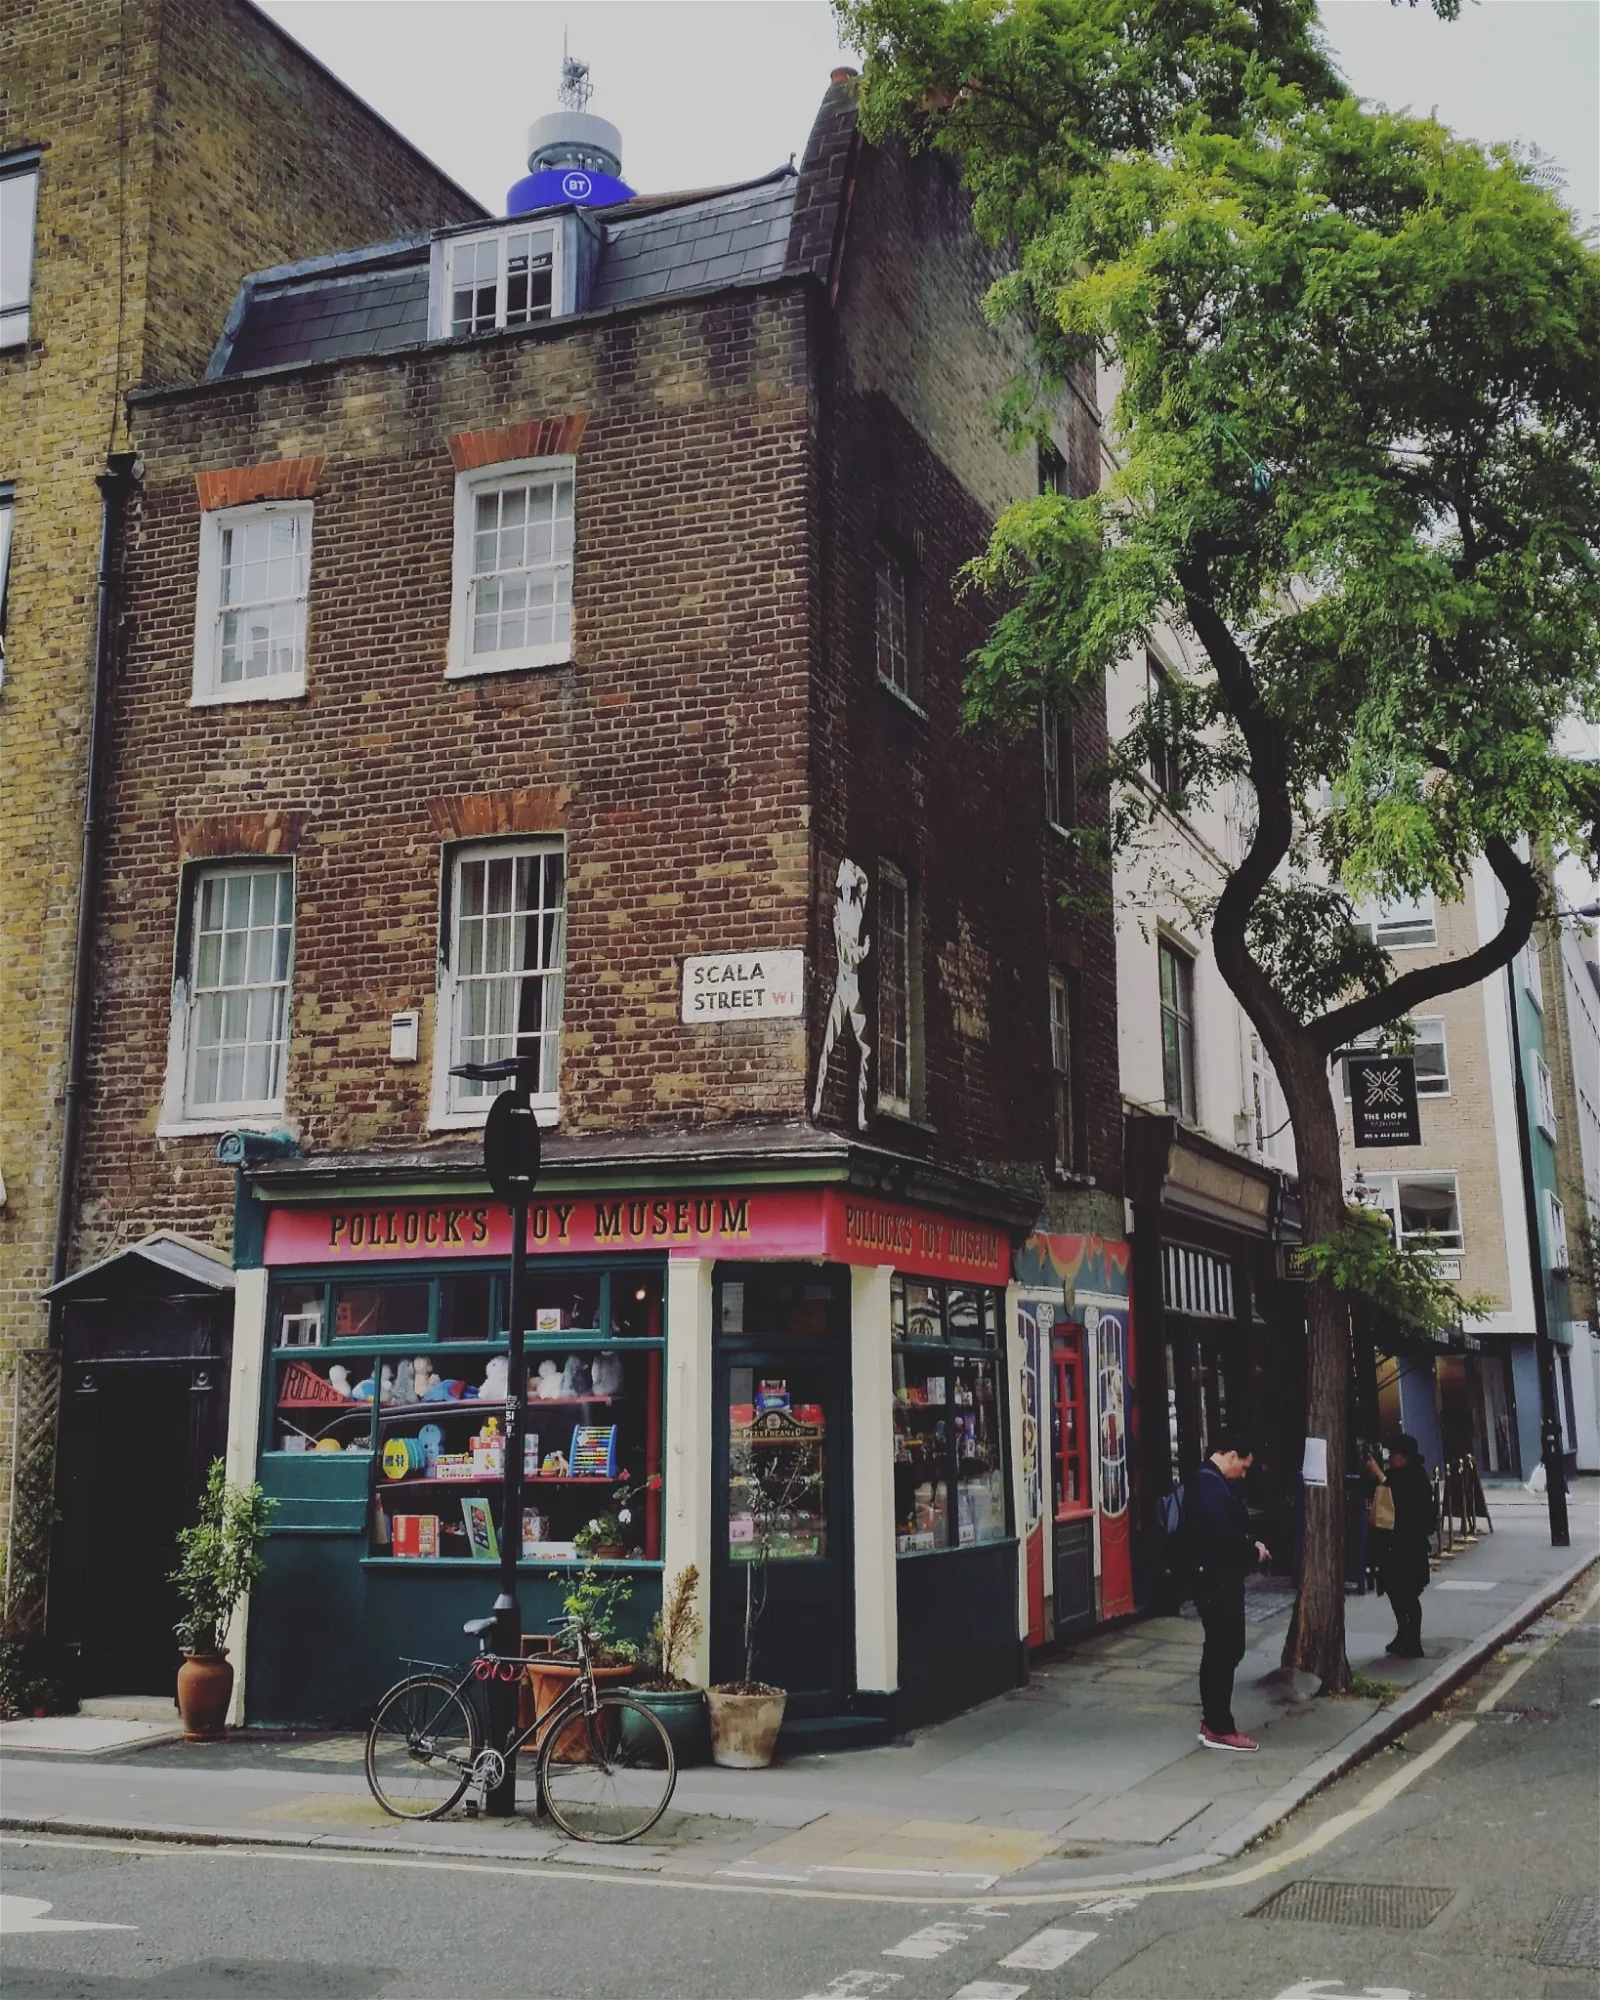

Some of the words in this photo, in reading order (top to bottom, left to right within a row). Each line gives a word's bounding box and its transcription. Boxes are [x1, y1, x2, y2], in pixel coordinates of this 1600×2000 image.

[569, 180, 585, 191] BT
[694, 963, 766, 985] SCALA
[694, 988, 766, 1011] STREET
[1364, 1113, 1380, 1121] THE
[1383, 1112, 1408, 1120] HOPE
[328, 1206, 490, 1254] POLLOCK'S
[508, 1204, 577, 1246] OY
[594, 1197, 752, 1245] MUSEUM
[845, 1204, 913, 1256] POLLOCK'S
[919, 1220, 944, 1259] TOY
[949, 1227, 999, 1269] MUSEUM
